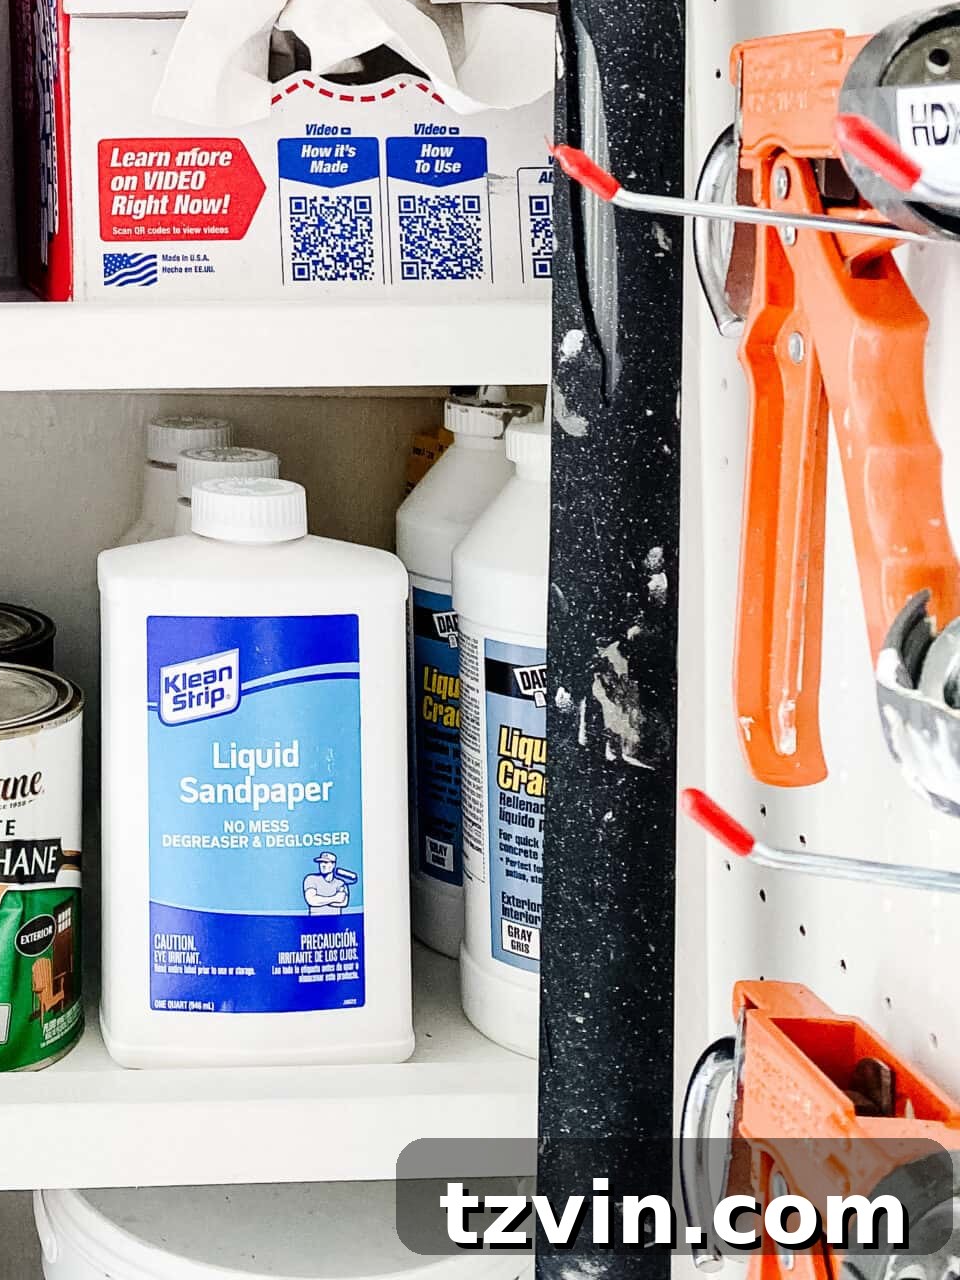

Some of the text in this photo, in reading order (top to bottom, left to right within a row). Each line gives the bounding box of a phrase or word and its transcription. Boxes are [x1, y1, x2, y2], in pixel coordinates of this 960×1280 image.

[306, 124, 338, 136] Video
[414, 124, 447, 136] Video
[110, 148, 232, 167] Learn more
[301, 143, 356, 158] How it's
[420, 143, 453, 158] How
[310, 160, 348, 173] Made
[415, 159, 462, 173] To Use
[110, 171, 206, 191] on VIDEO
[111, 195, 231, 220] Right Now!
[112, 226, 229, 236] Scan QR codes to view videos
[164, 665, 233, 693] Klean
[172, 686, 224, 712] Strip
[212, 739, 300, 776] Liquid
[179, 775, 333, 811] Sandpaper
[223, 820, 289, 832] NO MESS
[162, 832, 350, 848] DEGREASER & DEGLOSSER
[499, 828, 539, 848] For quick
[499, 842, 538, 860] concrete
[502, 904, 540, 925] Interior
[20, 925, 53, 945] EXTERIOR
[154, 934, 197, 950] CAUTION.
[301, 928, 358, 950] PRECAUCIÓN.
[508, 925, 532, 942] GRAY
[511, 940, 530, 953] GRIS
